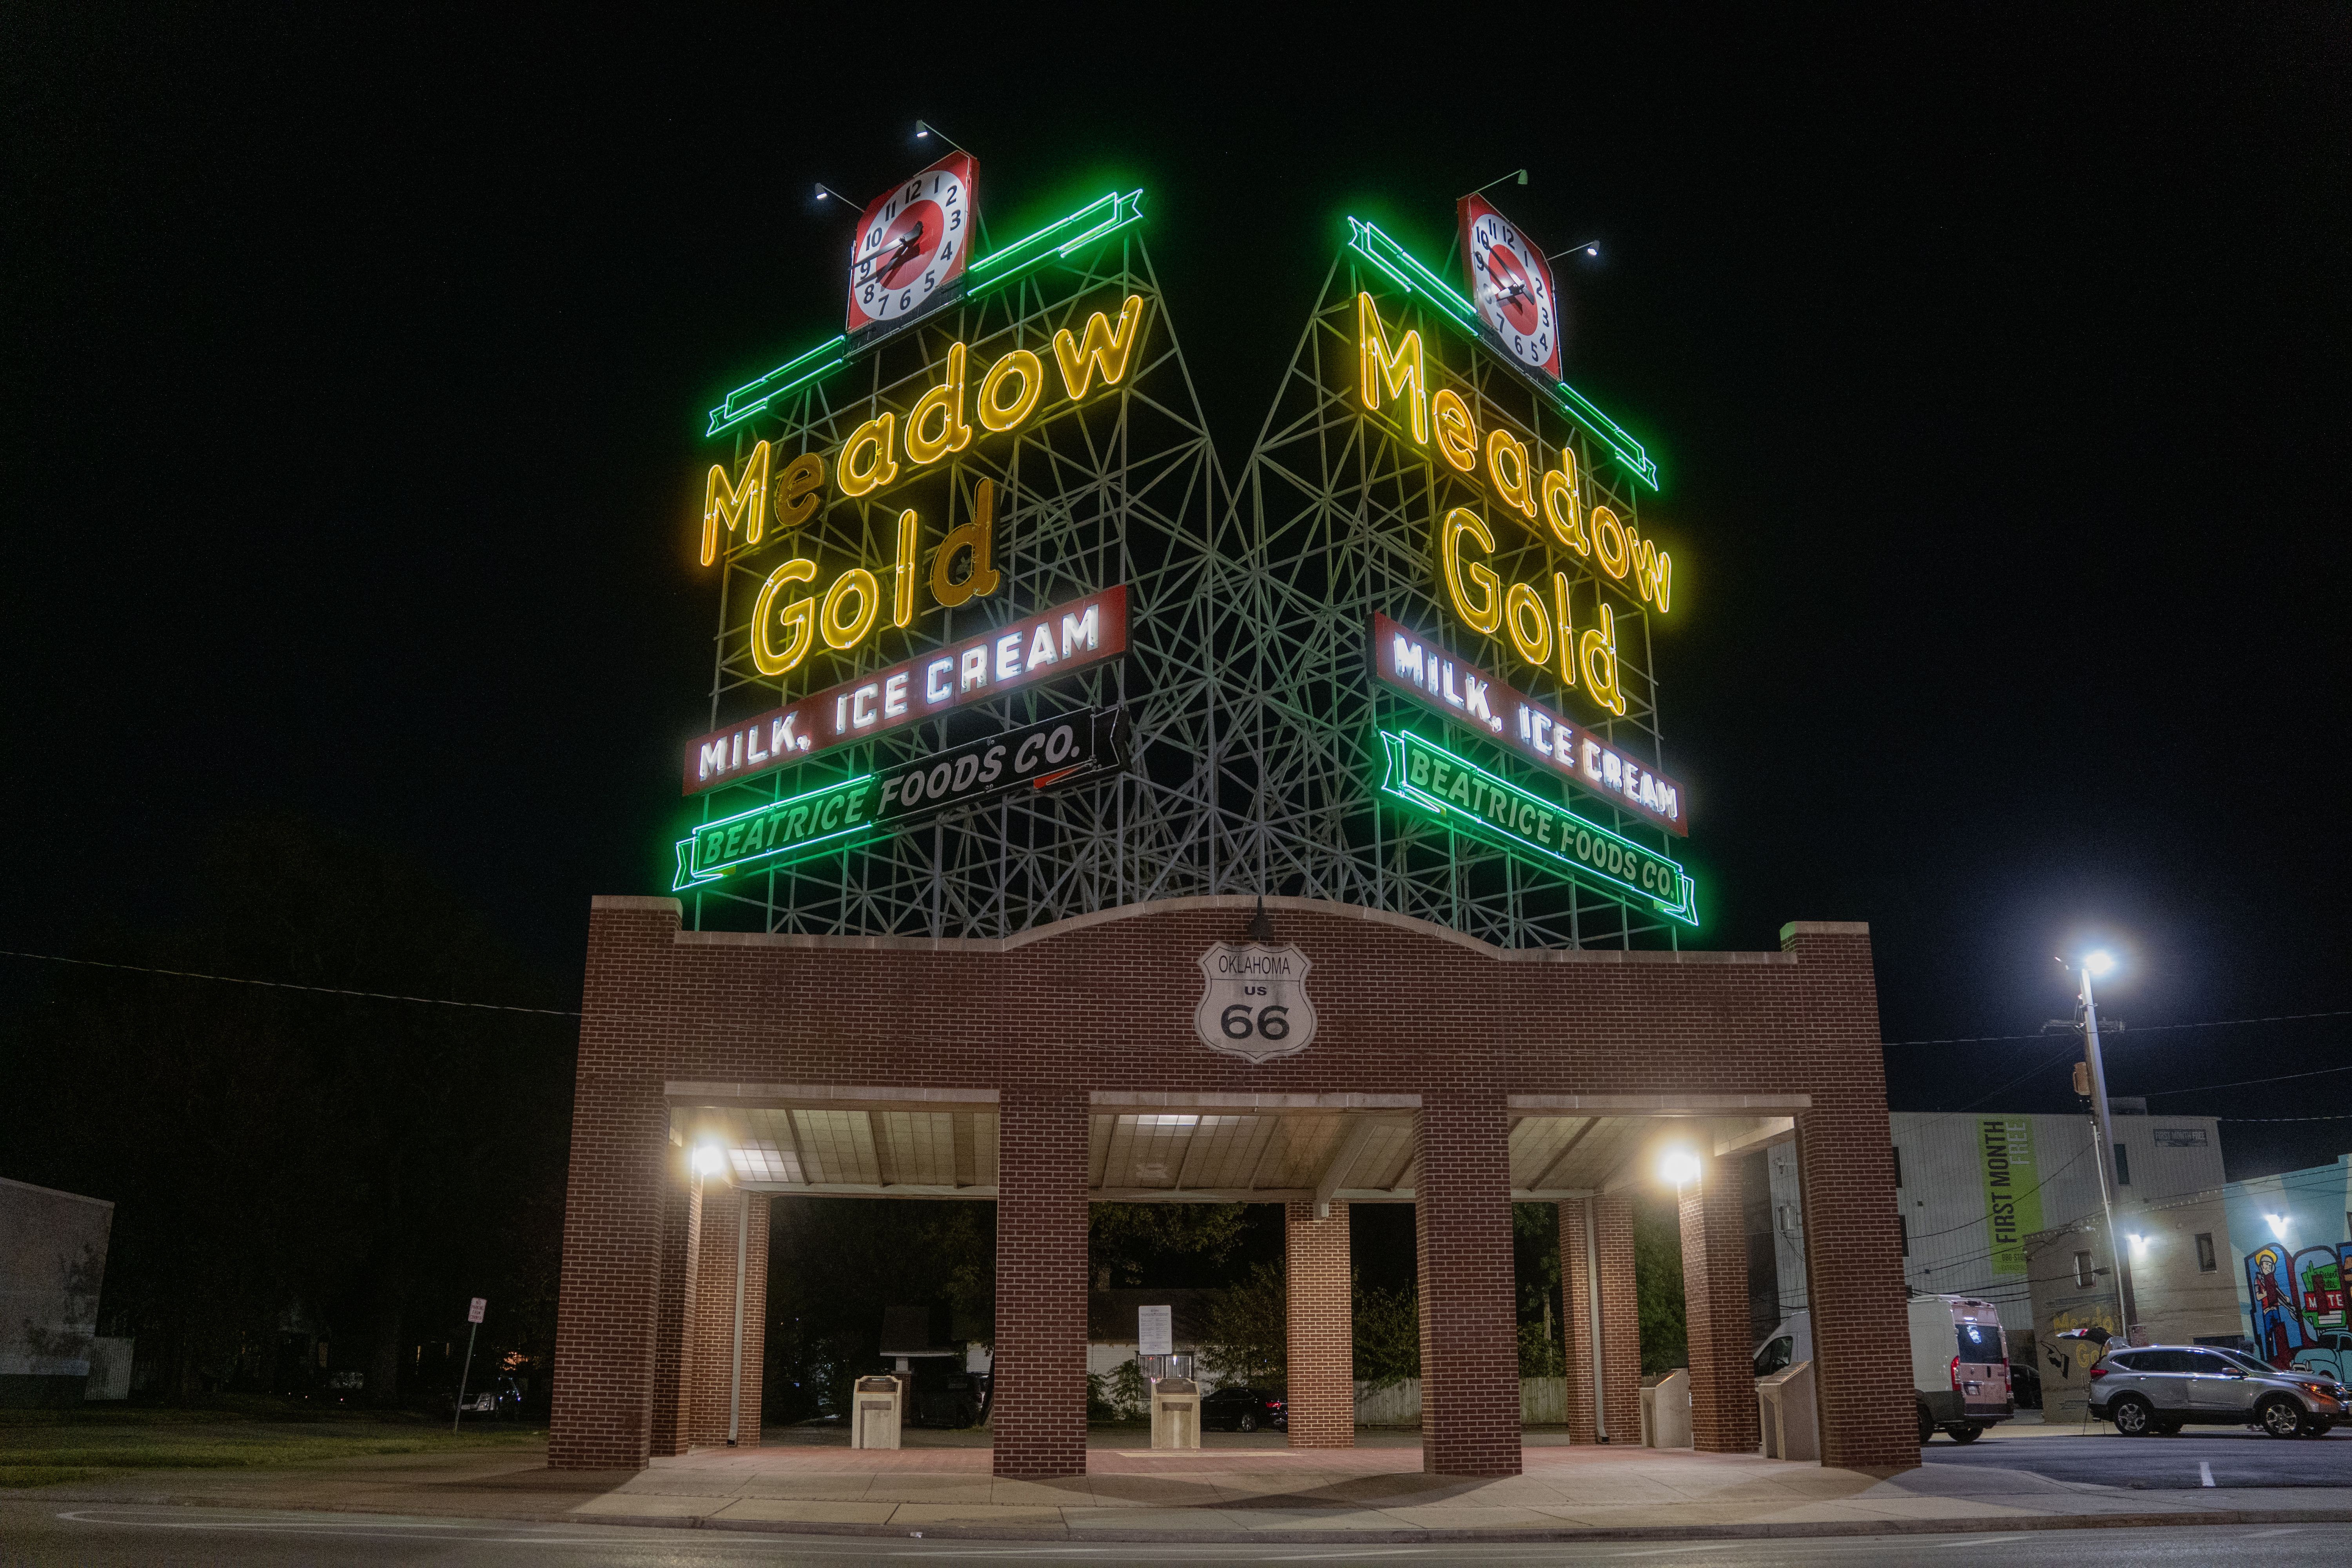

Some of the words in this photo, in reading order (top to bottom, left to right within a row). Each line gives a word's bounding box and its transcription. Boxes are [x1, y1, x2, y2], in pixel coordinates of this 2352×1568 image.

[906, 180, 922, 204] 12
[934, 175, 939, 194] 1
[946, 185, 957, 207] 2
[885, 200, 896, 221] 11
[950, 209, 960, 231] 3
[866, 227, 882, 251] 10
[1476, 226, 1490, 250] 10
[1489, 219, 1497, 240] 11
[1503, 226, 1515, 250] 12
[940, 241, 952, 261] 4
[1476, 251, 1484, 271] 9
[1524, 251, 1528, 267] 1
[860, 260, 870, 280] 9
[924, 270, 935, 292] 5
[863, 283, 874, 304] 8
[1536, 277, 1543, 299] 2
[878, 294, 889, 316] 7
[900, 289, 910, 310] 6
[1497, 312, 1505, 333] 7
[1542, 307, 1550, 327] 3
[1515, 335, 1523, 355] 6
[1531, 341, 1538, 362] 5
[1540, 332, 1548, 351] 4
[700, 294, 1143, 567] Meadow
[1358, 292, 1671, 613] Meadow
[751, 476, 1000, 676] Gold
[1442, 507, 1626, 716] Gold
[699, 710, 811, 782] MILK,
[835, 671, 909, 735] ICE
[926, 604, 1099, 704] CREAM
[1394, 631, 1502, 732] MILK,
[1519, 701, 1574, 767] ICE
[1582, 737, 1677, 822] CREAM
[703, 786, 869, 864] BEATRICE
[877, 745, 1002, 815] FOODS
[1014, 724, 1080, 775] CO.
[1411, 748, 1555, 844] BEATRICE
[1561, 820, 1637, 883] FOODS
[1642, 860, 1675, 898] CO.
[1218, 955, 1290, 975] OKLAHOMA
[1244, 986, 1267, 996] US
[1220, 1004, 1290, 1040] 66
[1984, 1122, 2011, 1187] MONTH
[2005, 1122, 2030, 1165] FREE
[1991, 1192, 2017, 1243] FIRST
